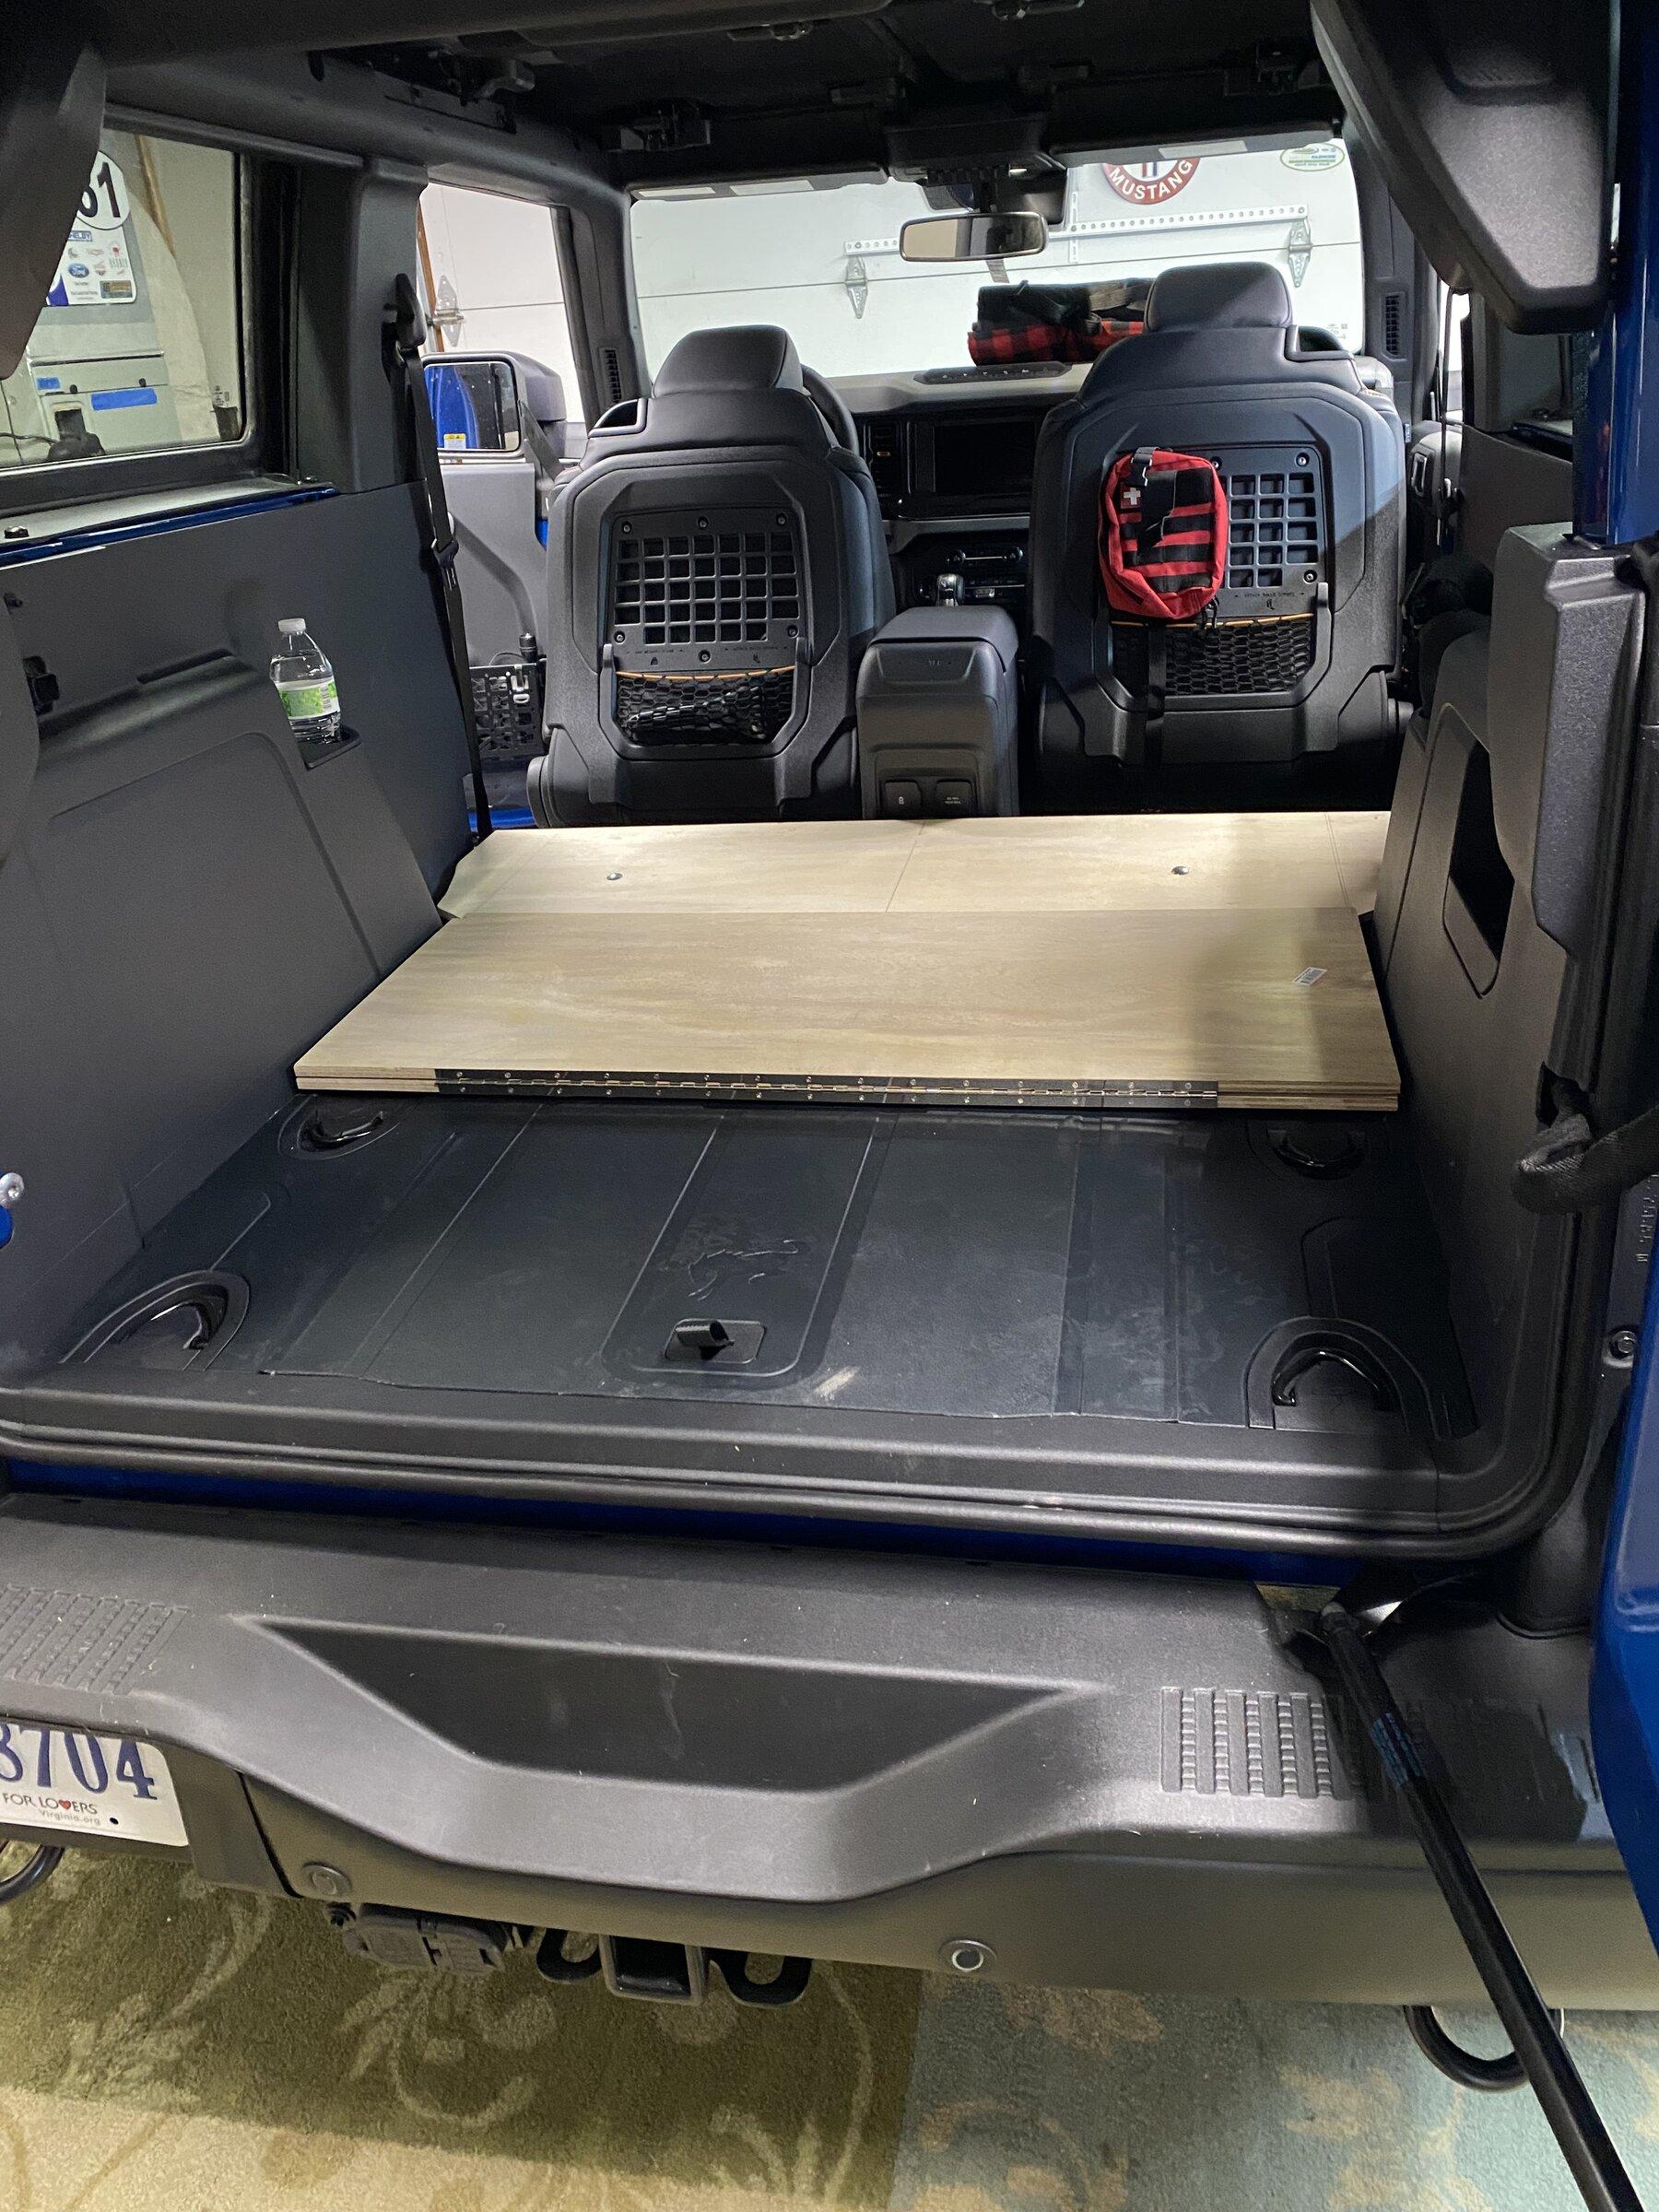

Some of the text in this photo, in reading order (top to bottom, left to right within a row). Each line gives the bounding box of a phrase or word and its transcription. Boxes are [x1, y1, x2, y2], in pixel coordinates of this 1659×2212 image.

[1109, 159, 1194, 200] MUSTANG
[2, 1792, 98, 1815] FOR LOERS
[39, 1808, 101, 1826] Virginia.org
